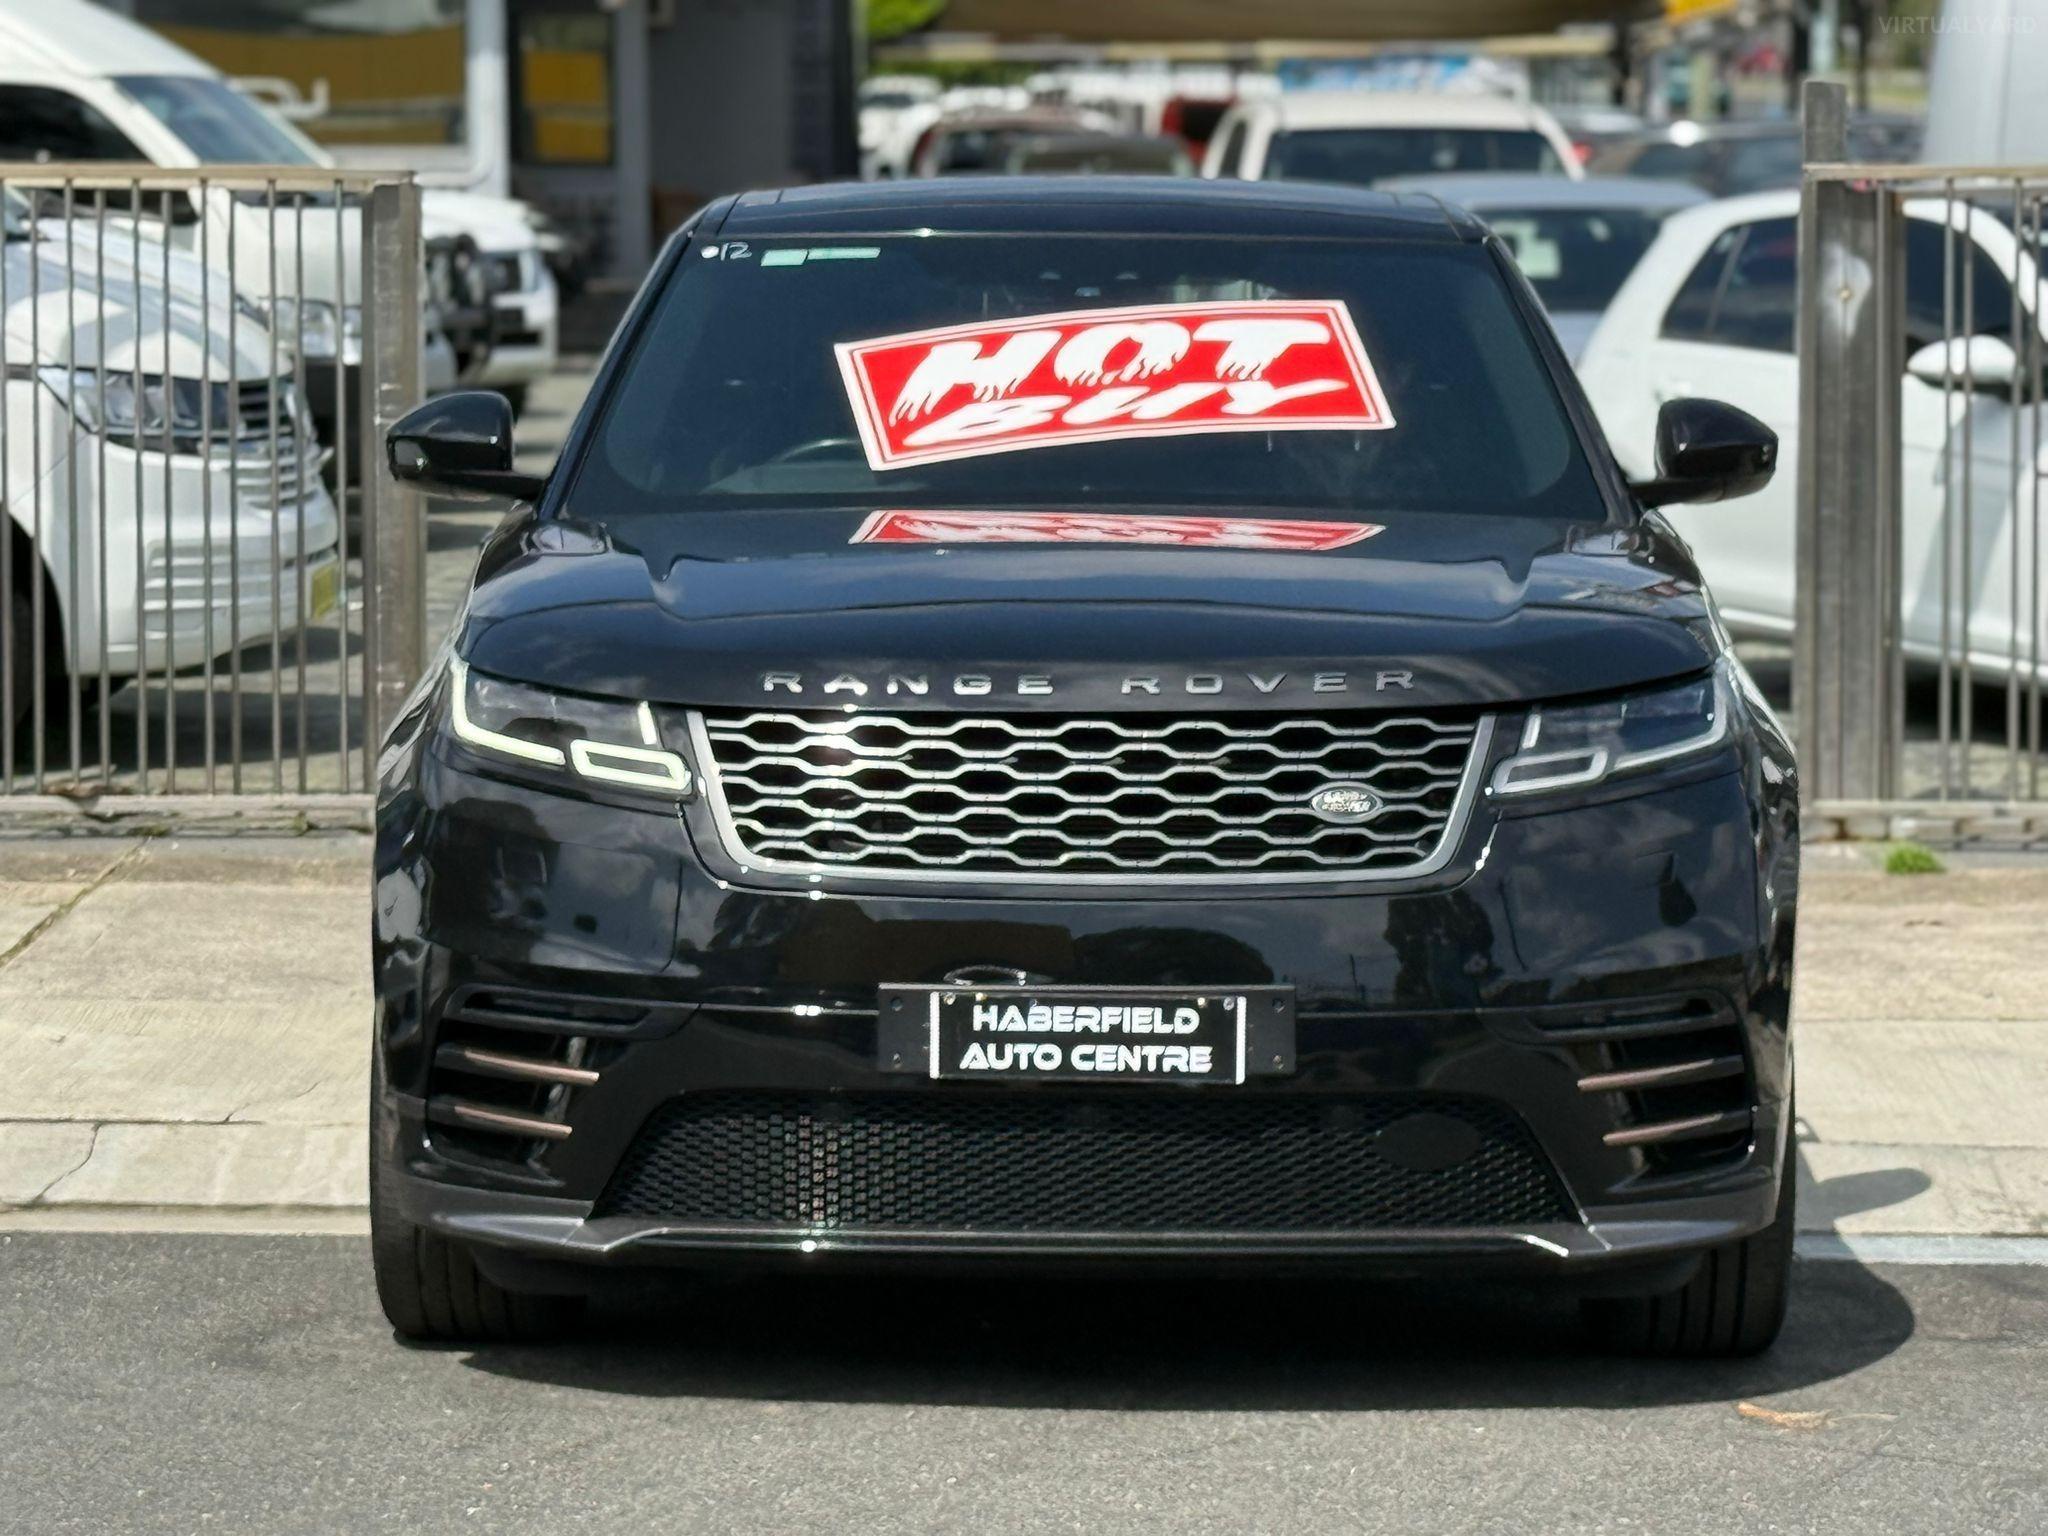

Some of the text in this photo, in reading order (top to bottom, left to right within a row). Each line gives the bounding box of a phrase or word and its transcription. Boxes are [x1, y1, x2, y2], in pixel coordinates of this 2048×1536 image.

[889, 319, 1331, 426] HOT
[903, 380, 1349, 446] BUY
[761, 671, 1415, 695] RANGE ROVER
[973, 1004, 1200, 1034] HABERFIELD
[960, 1042, 1213, 1073] AUTO CENTRE
